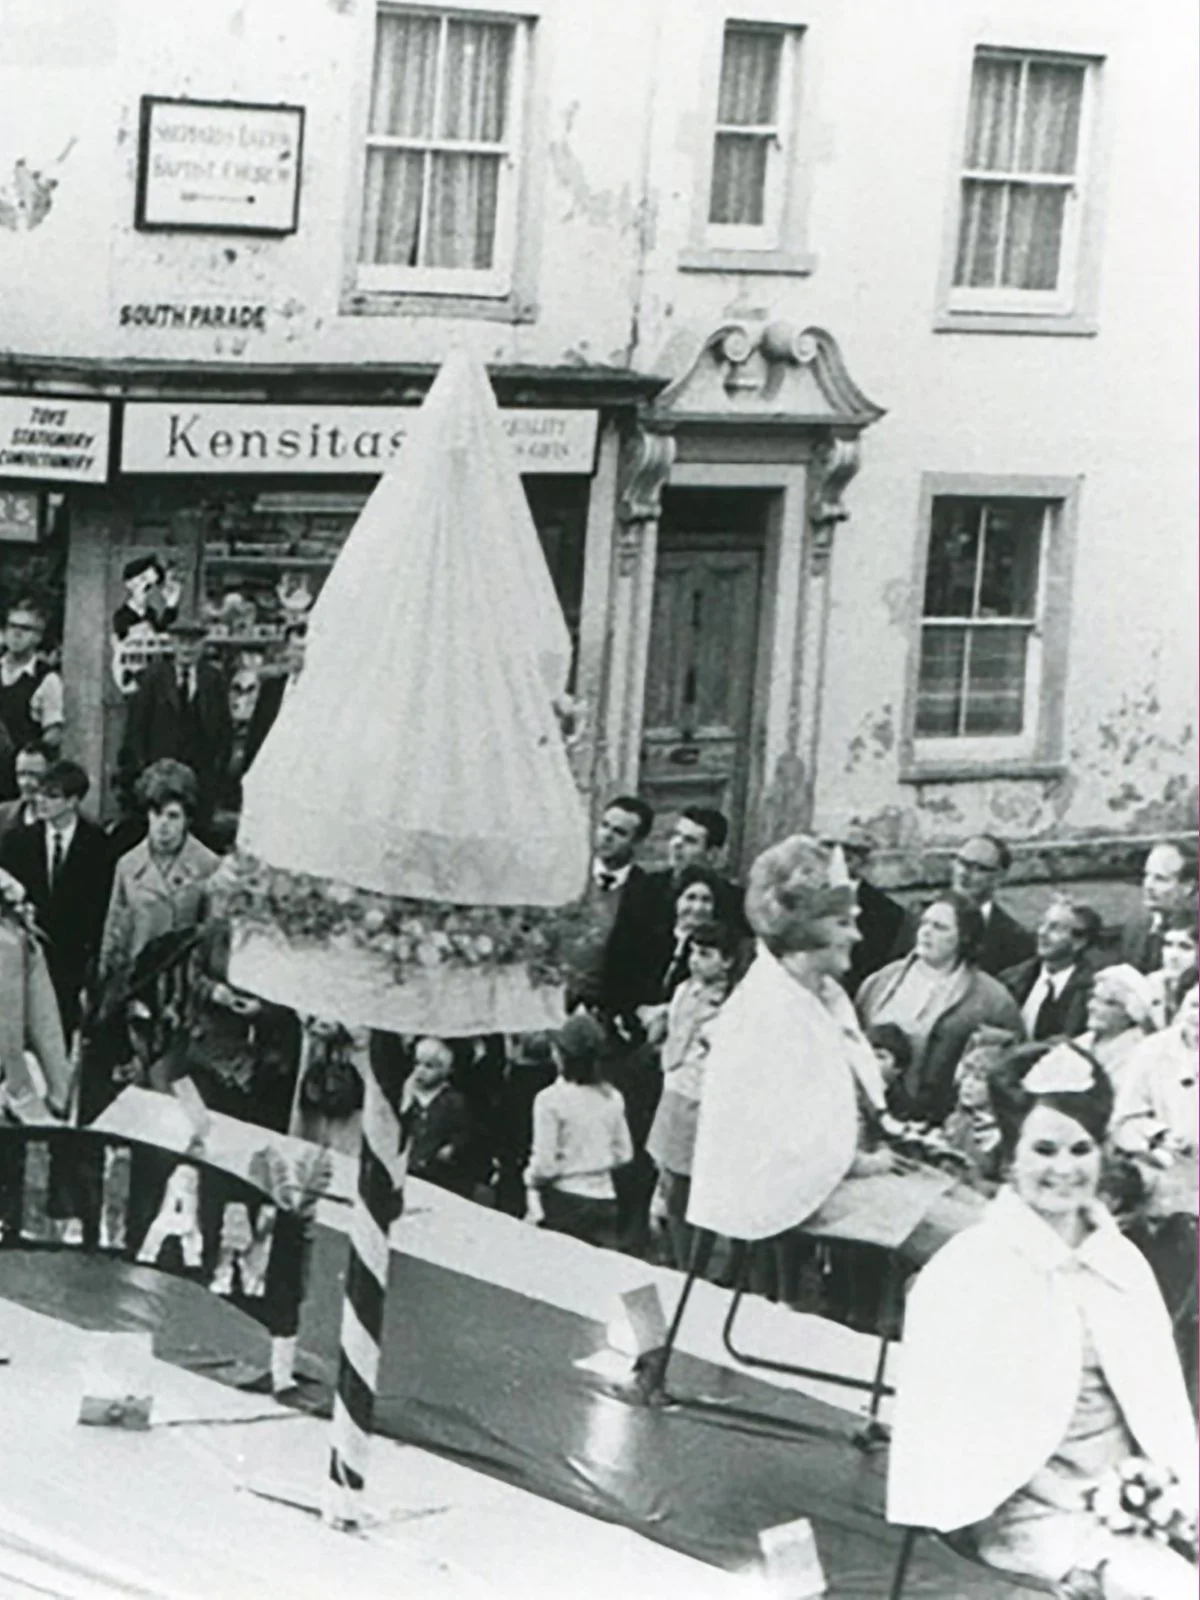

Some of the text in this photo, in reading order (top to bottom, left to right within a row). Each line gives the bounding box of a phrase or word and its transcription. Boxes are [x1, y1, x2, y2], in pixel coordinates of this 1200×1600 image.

[120, 304, 266, 331] SOUTH PARADE
[29, 406, 69, 427] TOYS
[10, 428, 96, 450] STATIONERY
